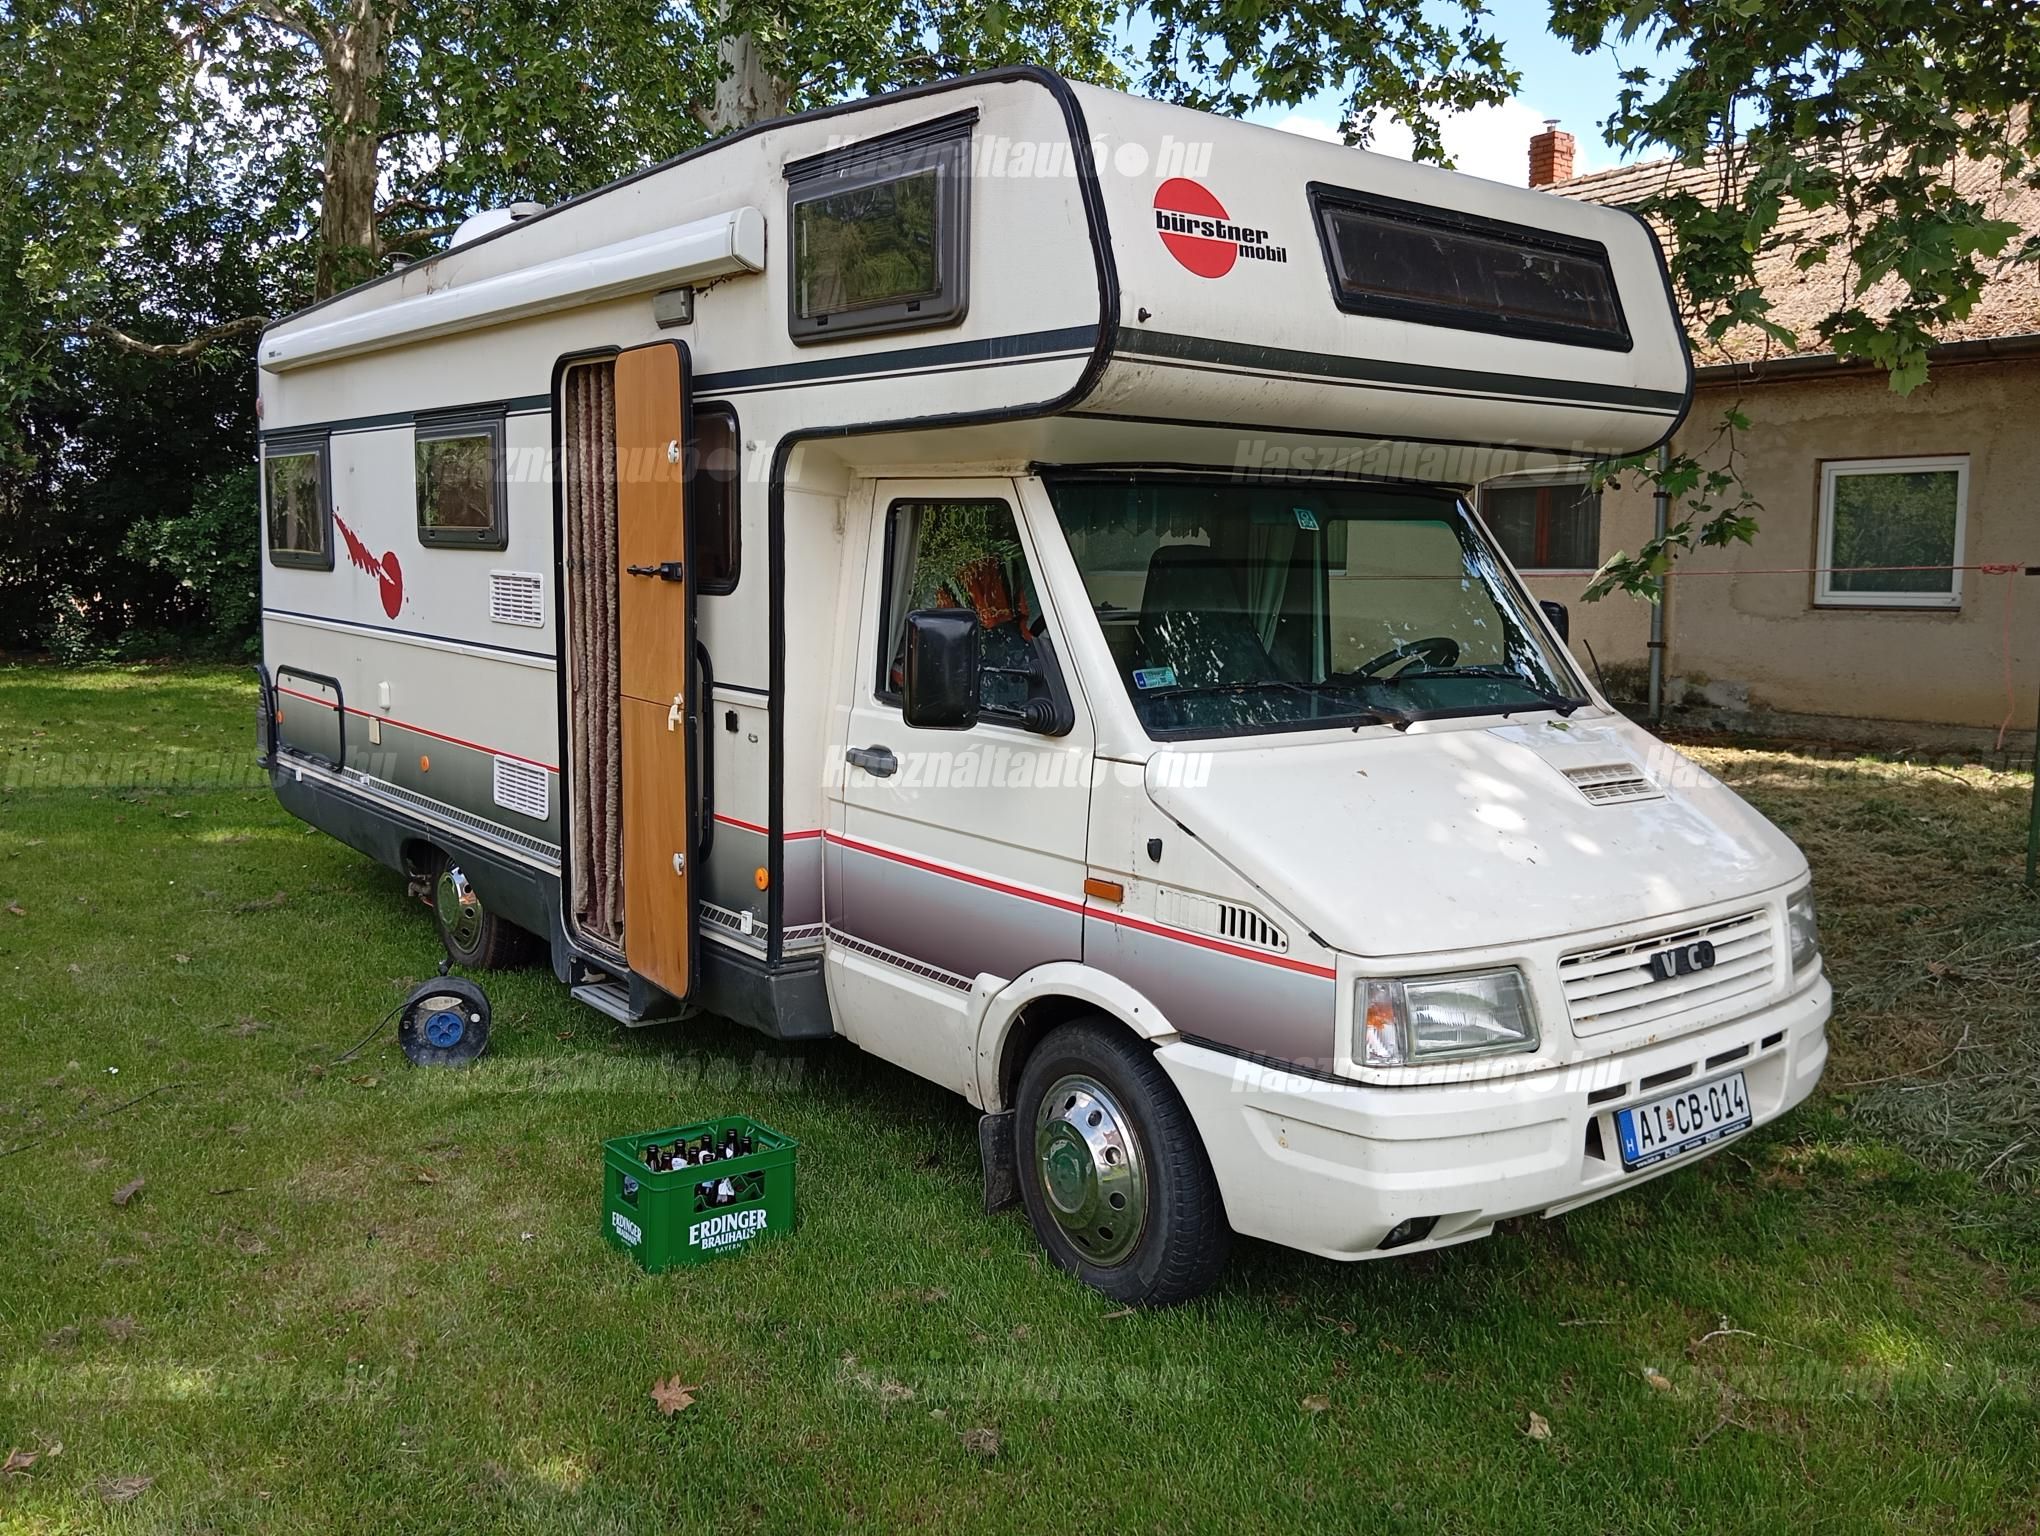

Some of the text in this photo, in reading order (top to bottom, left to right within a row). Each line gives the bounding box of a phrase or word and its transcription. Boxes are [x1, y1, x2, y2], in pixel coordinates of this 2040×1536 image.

[1156, 210, 1268, 244] bürstner
[1239, 244, 1287, 263] mobil
[1651, 941, 1715, 981] VCO
[1640, 1105, 1667, 1149] AI
[1626, 1138, 1635, 1153] H
[688, 1209, 768, 1245] ERDINGER
[701, 1227, 756, 1250] BRAUHAUS
[714, 1242, 742, 1254] BAYERN
